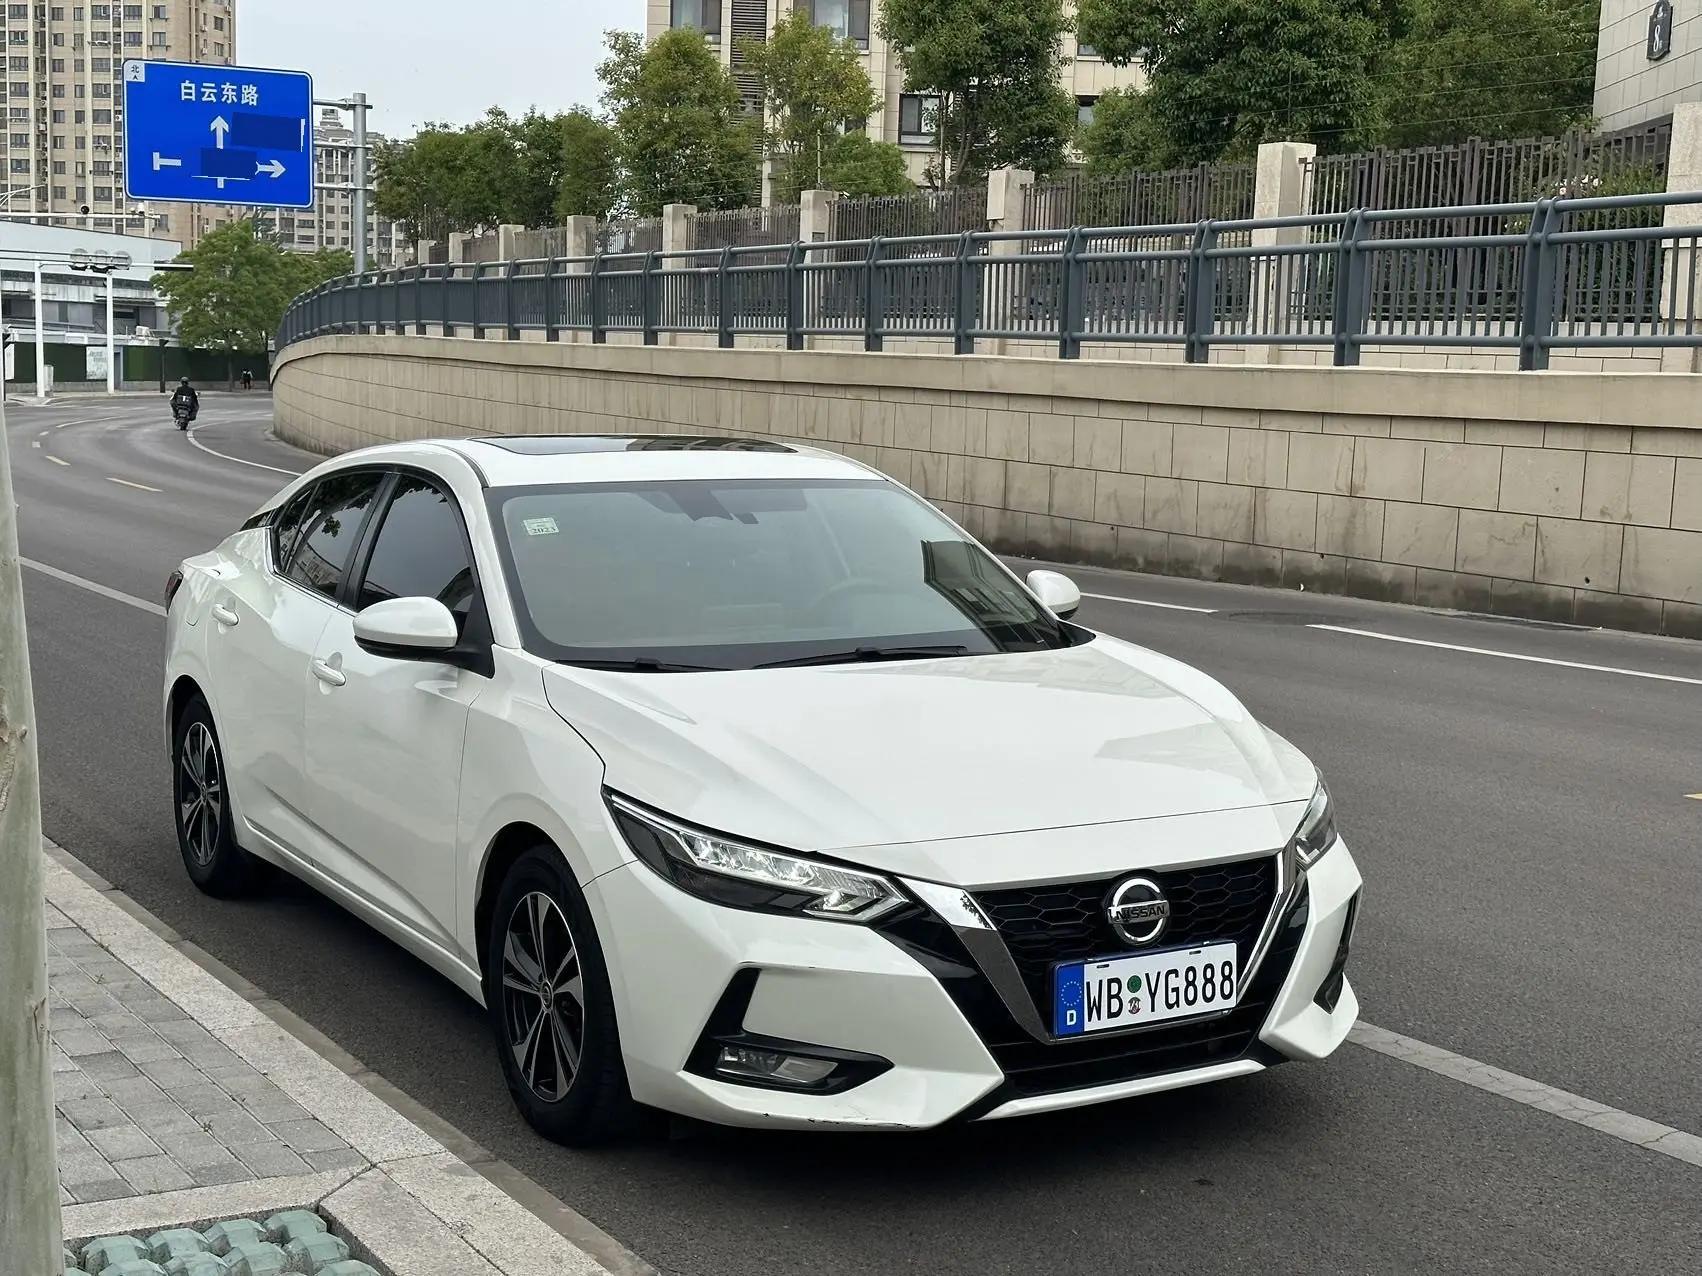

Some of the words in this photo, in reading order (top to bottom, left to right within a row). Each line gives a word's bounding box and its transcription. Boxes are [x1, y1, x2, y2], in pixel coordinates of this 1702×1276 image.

[130, 64, 140, 75] 北
[180, 80, 259, 106] 白云东路
[1115, 904, 1166, 921] NISSAN
[1086, 976, 1124, 1023] WB
[1144, 960, 1235, 1013] YG888
[1066, 1010, 1077, 1026] D
